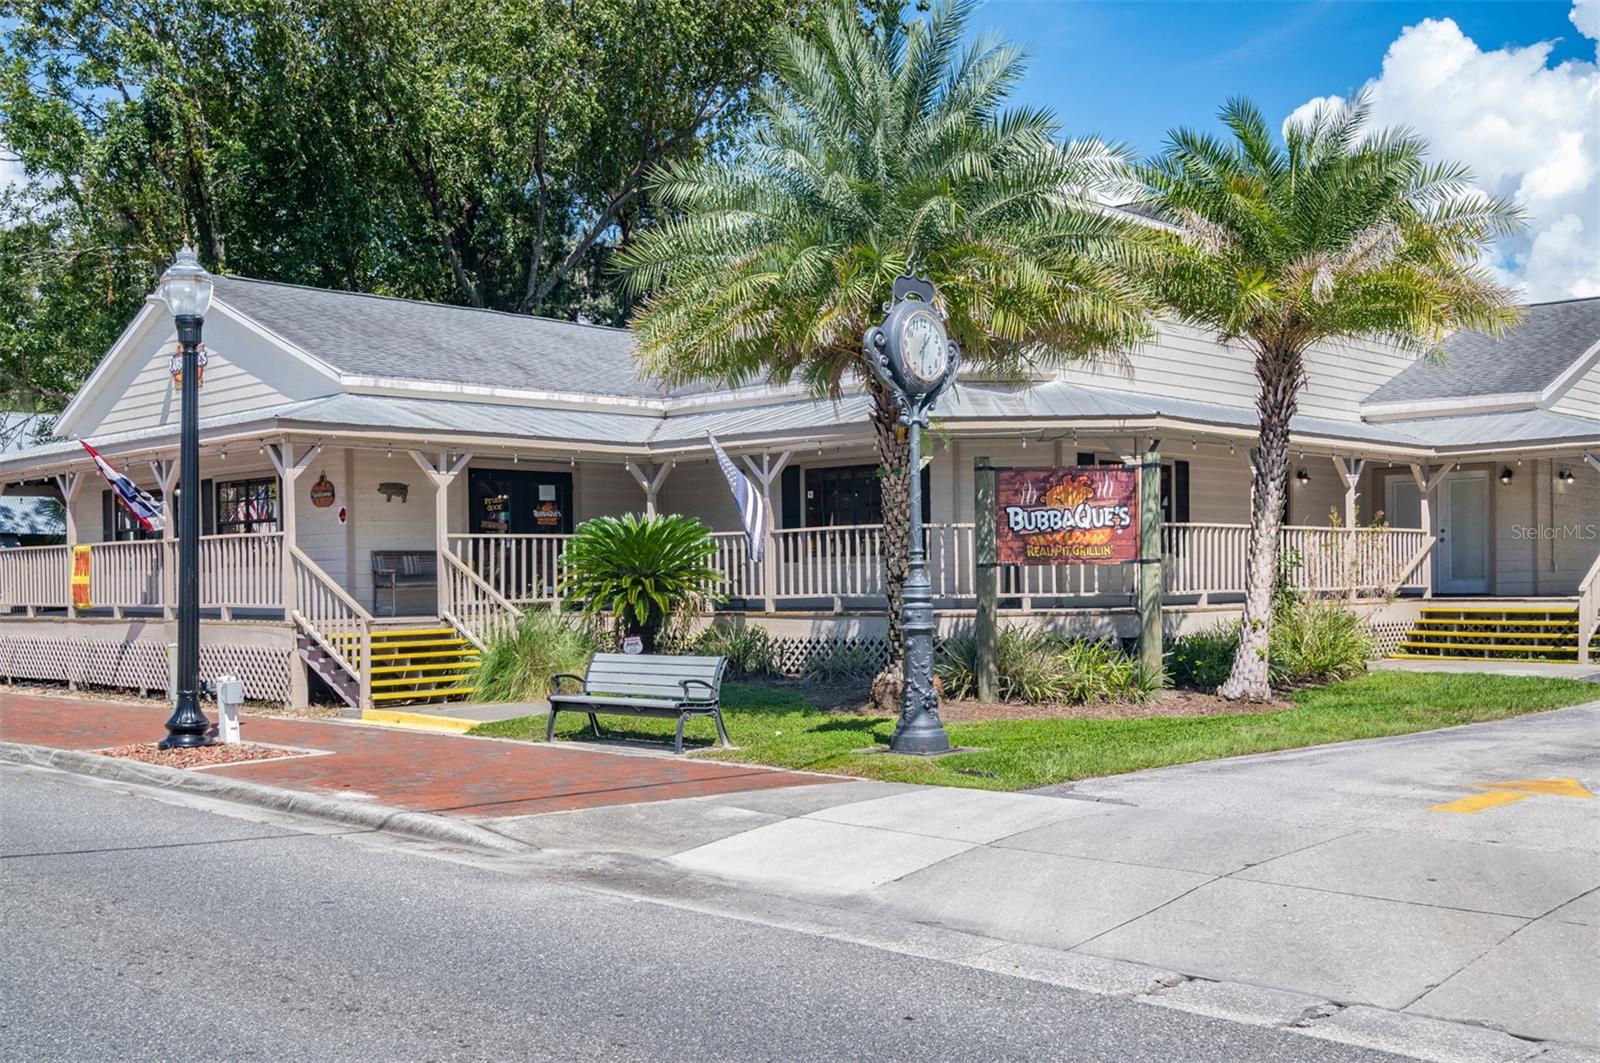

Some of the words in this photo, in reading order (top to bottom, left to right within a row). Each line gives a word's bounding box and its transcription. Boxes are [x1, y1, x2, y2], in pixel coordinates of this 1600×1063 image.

[1006, 503, 1131, 531] BUBBAQUE'S
[1027, 545, 1053, 557] REAL
[1054, 544, 1070, 557] PIT
[1072, 544, 1113, 557] GRILLIN'
